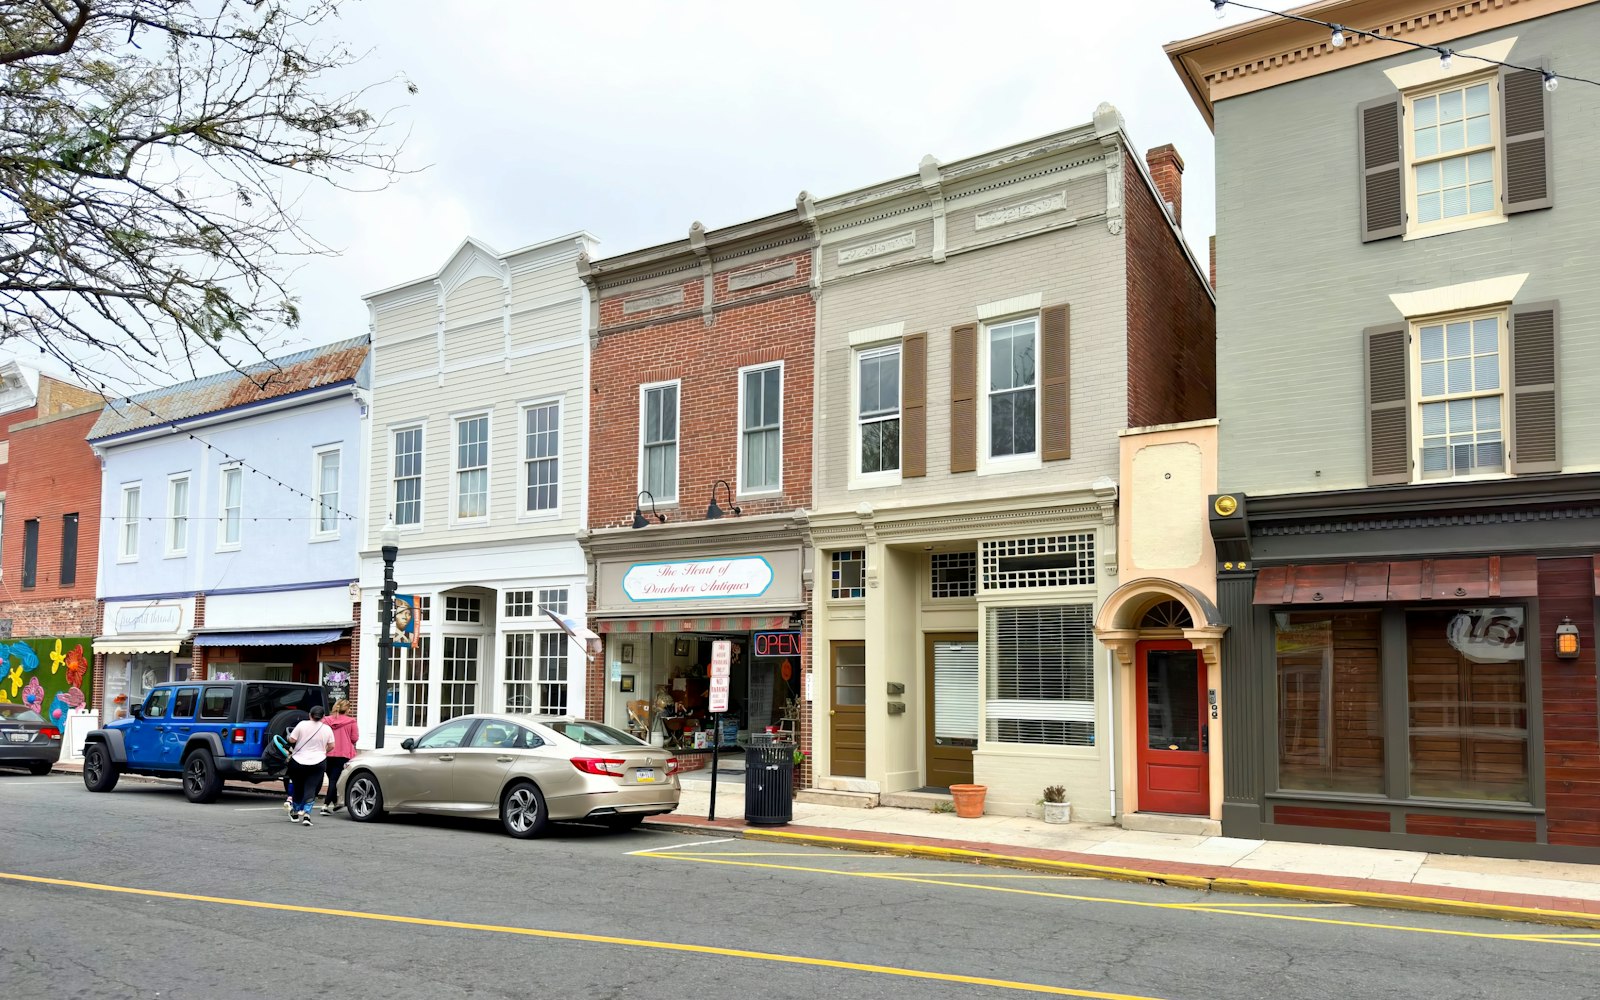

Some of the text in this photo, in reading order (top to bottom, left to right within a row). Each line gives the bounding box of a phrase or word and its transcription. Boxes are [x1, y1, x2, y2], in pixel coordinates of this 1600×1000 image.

[656, 560, 733, 577] The Heart of
[643, 580, 749, 594] Dorchester Antiques
[756, 634, 801, 655] OPEN
